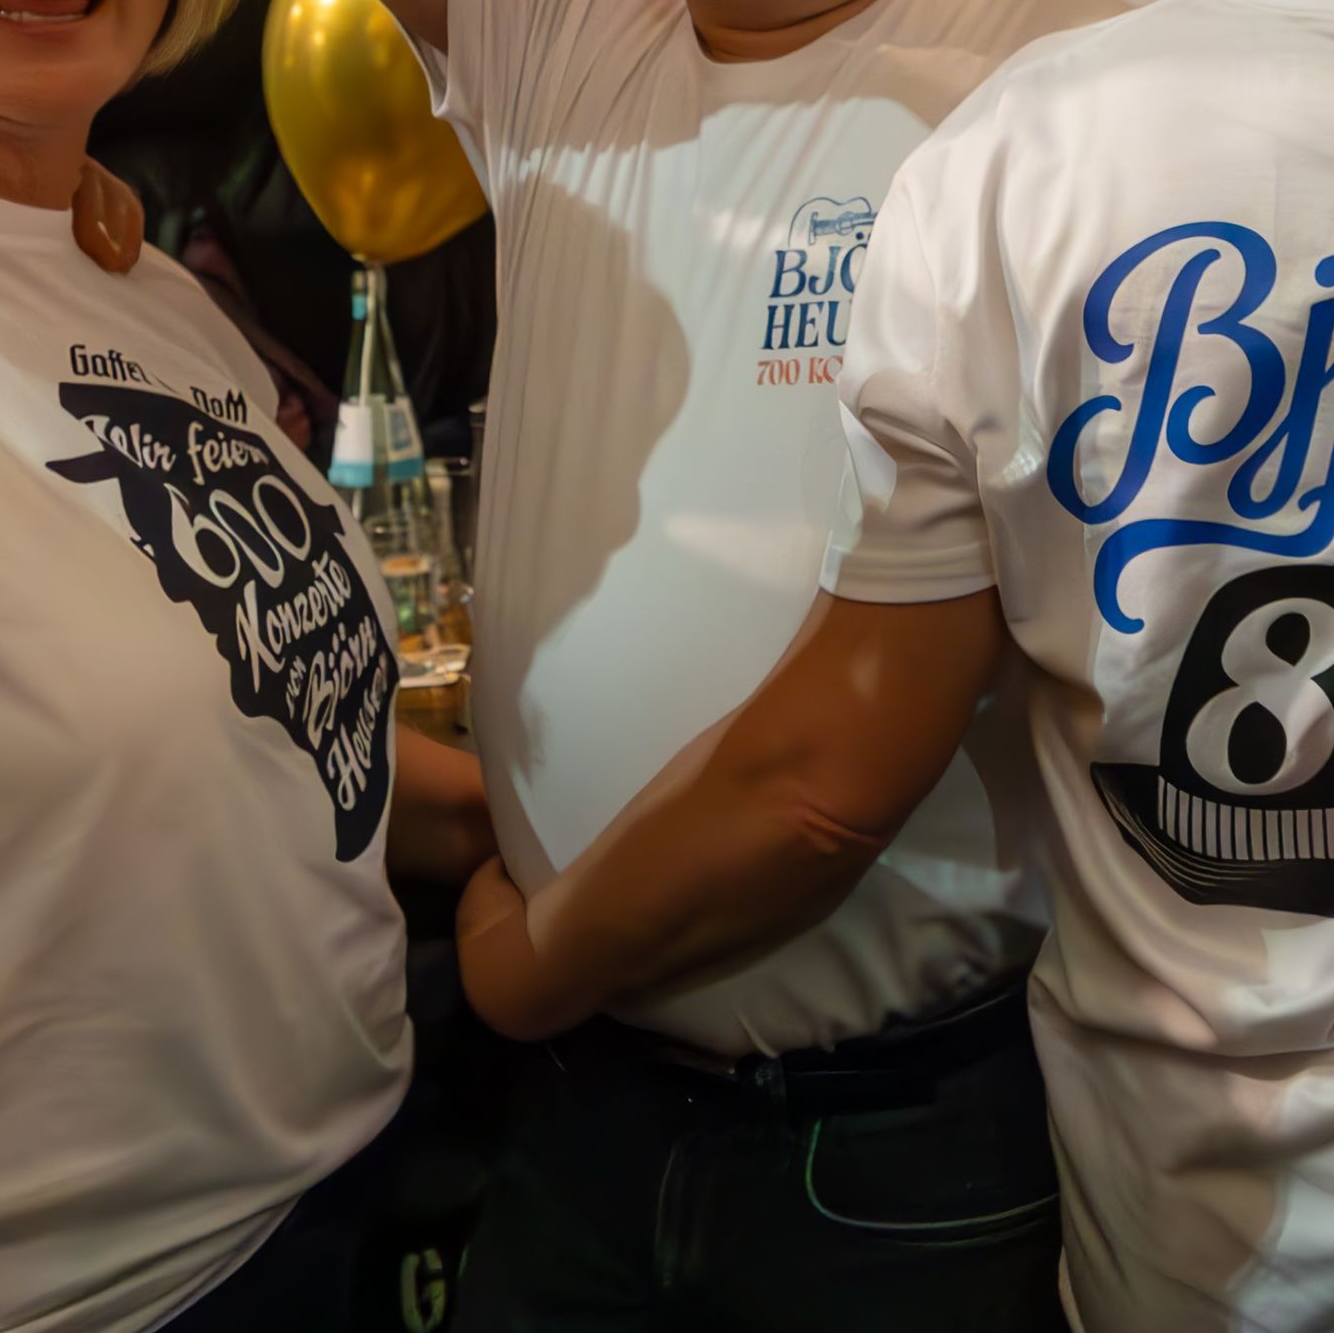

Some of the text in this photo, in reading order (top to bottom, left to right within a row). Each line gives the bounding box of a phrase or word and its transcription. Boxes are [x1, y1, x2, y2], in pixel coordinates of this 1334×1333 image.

[756, 358, 801, 386] 700
[163, 473, 312, 589] 600
[235, 550, 352, 694] Konzerte
[302, 615, 378, 752] Björn
